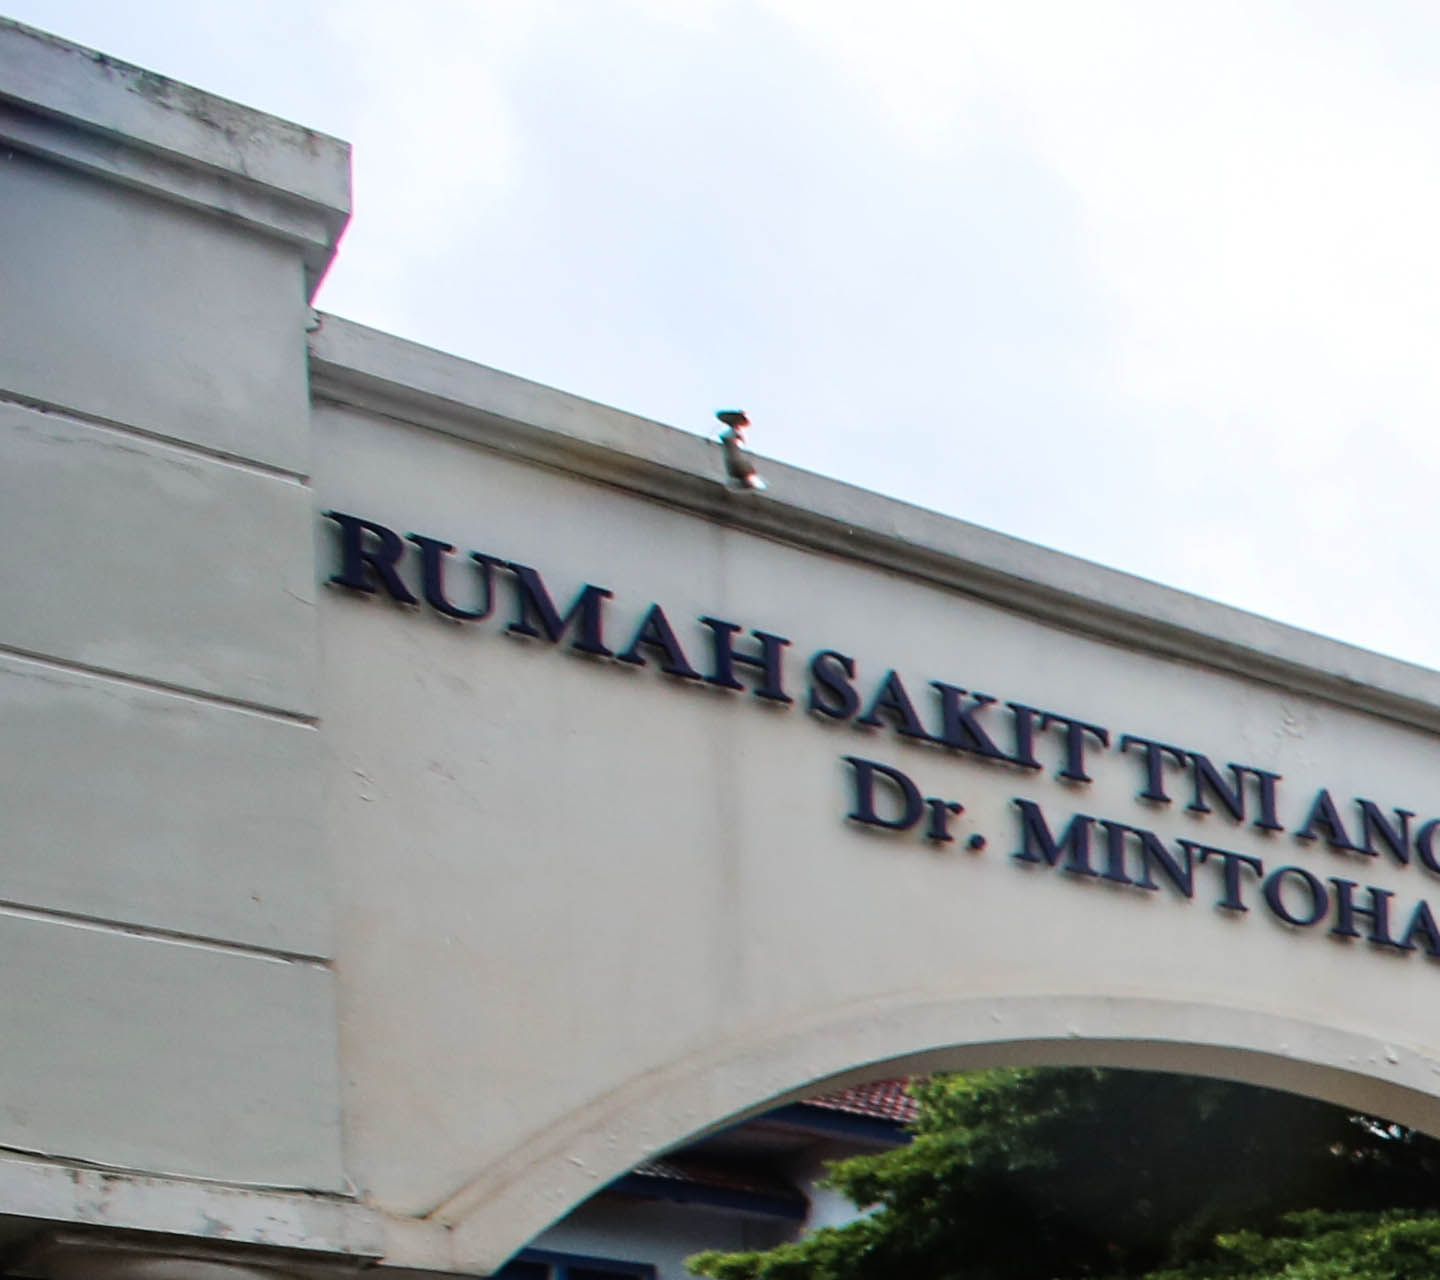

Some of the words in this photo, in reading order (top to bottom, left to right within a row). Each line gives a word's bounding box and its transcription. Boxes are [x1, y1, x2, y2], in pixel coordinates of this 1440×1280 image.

[322, 509, 793, 706] RUMAH
[808, 650, 1109, 785] SAKIT
[1119, 734, 1284, 835] TNI
[843, 755, 987, 853] Dr.
